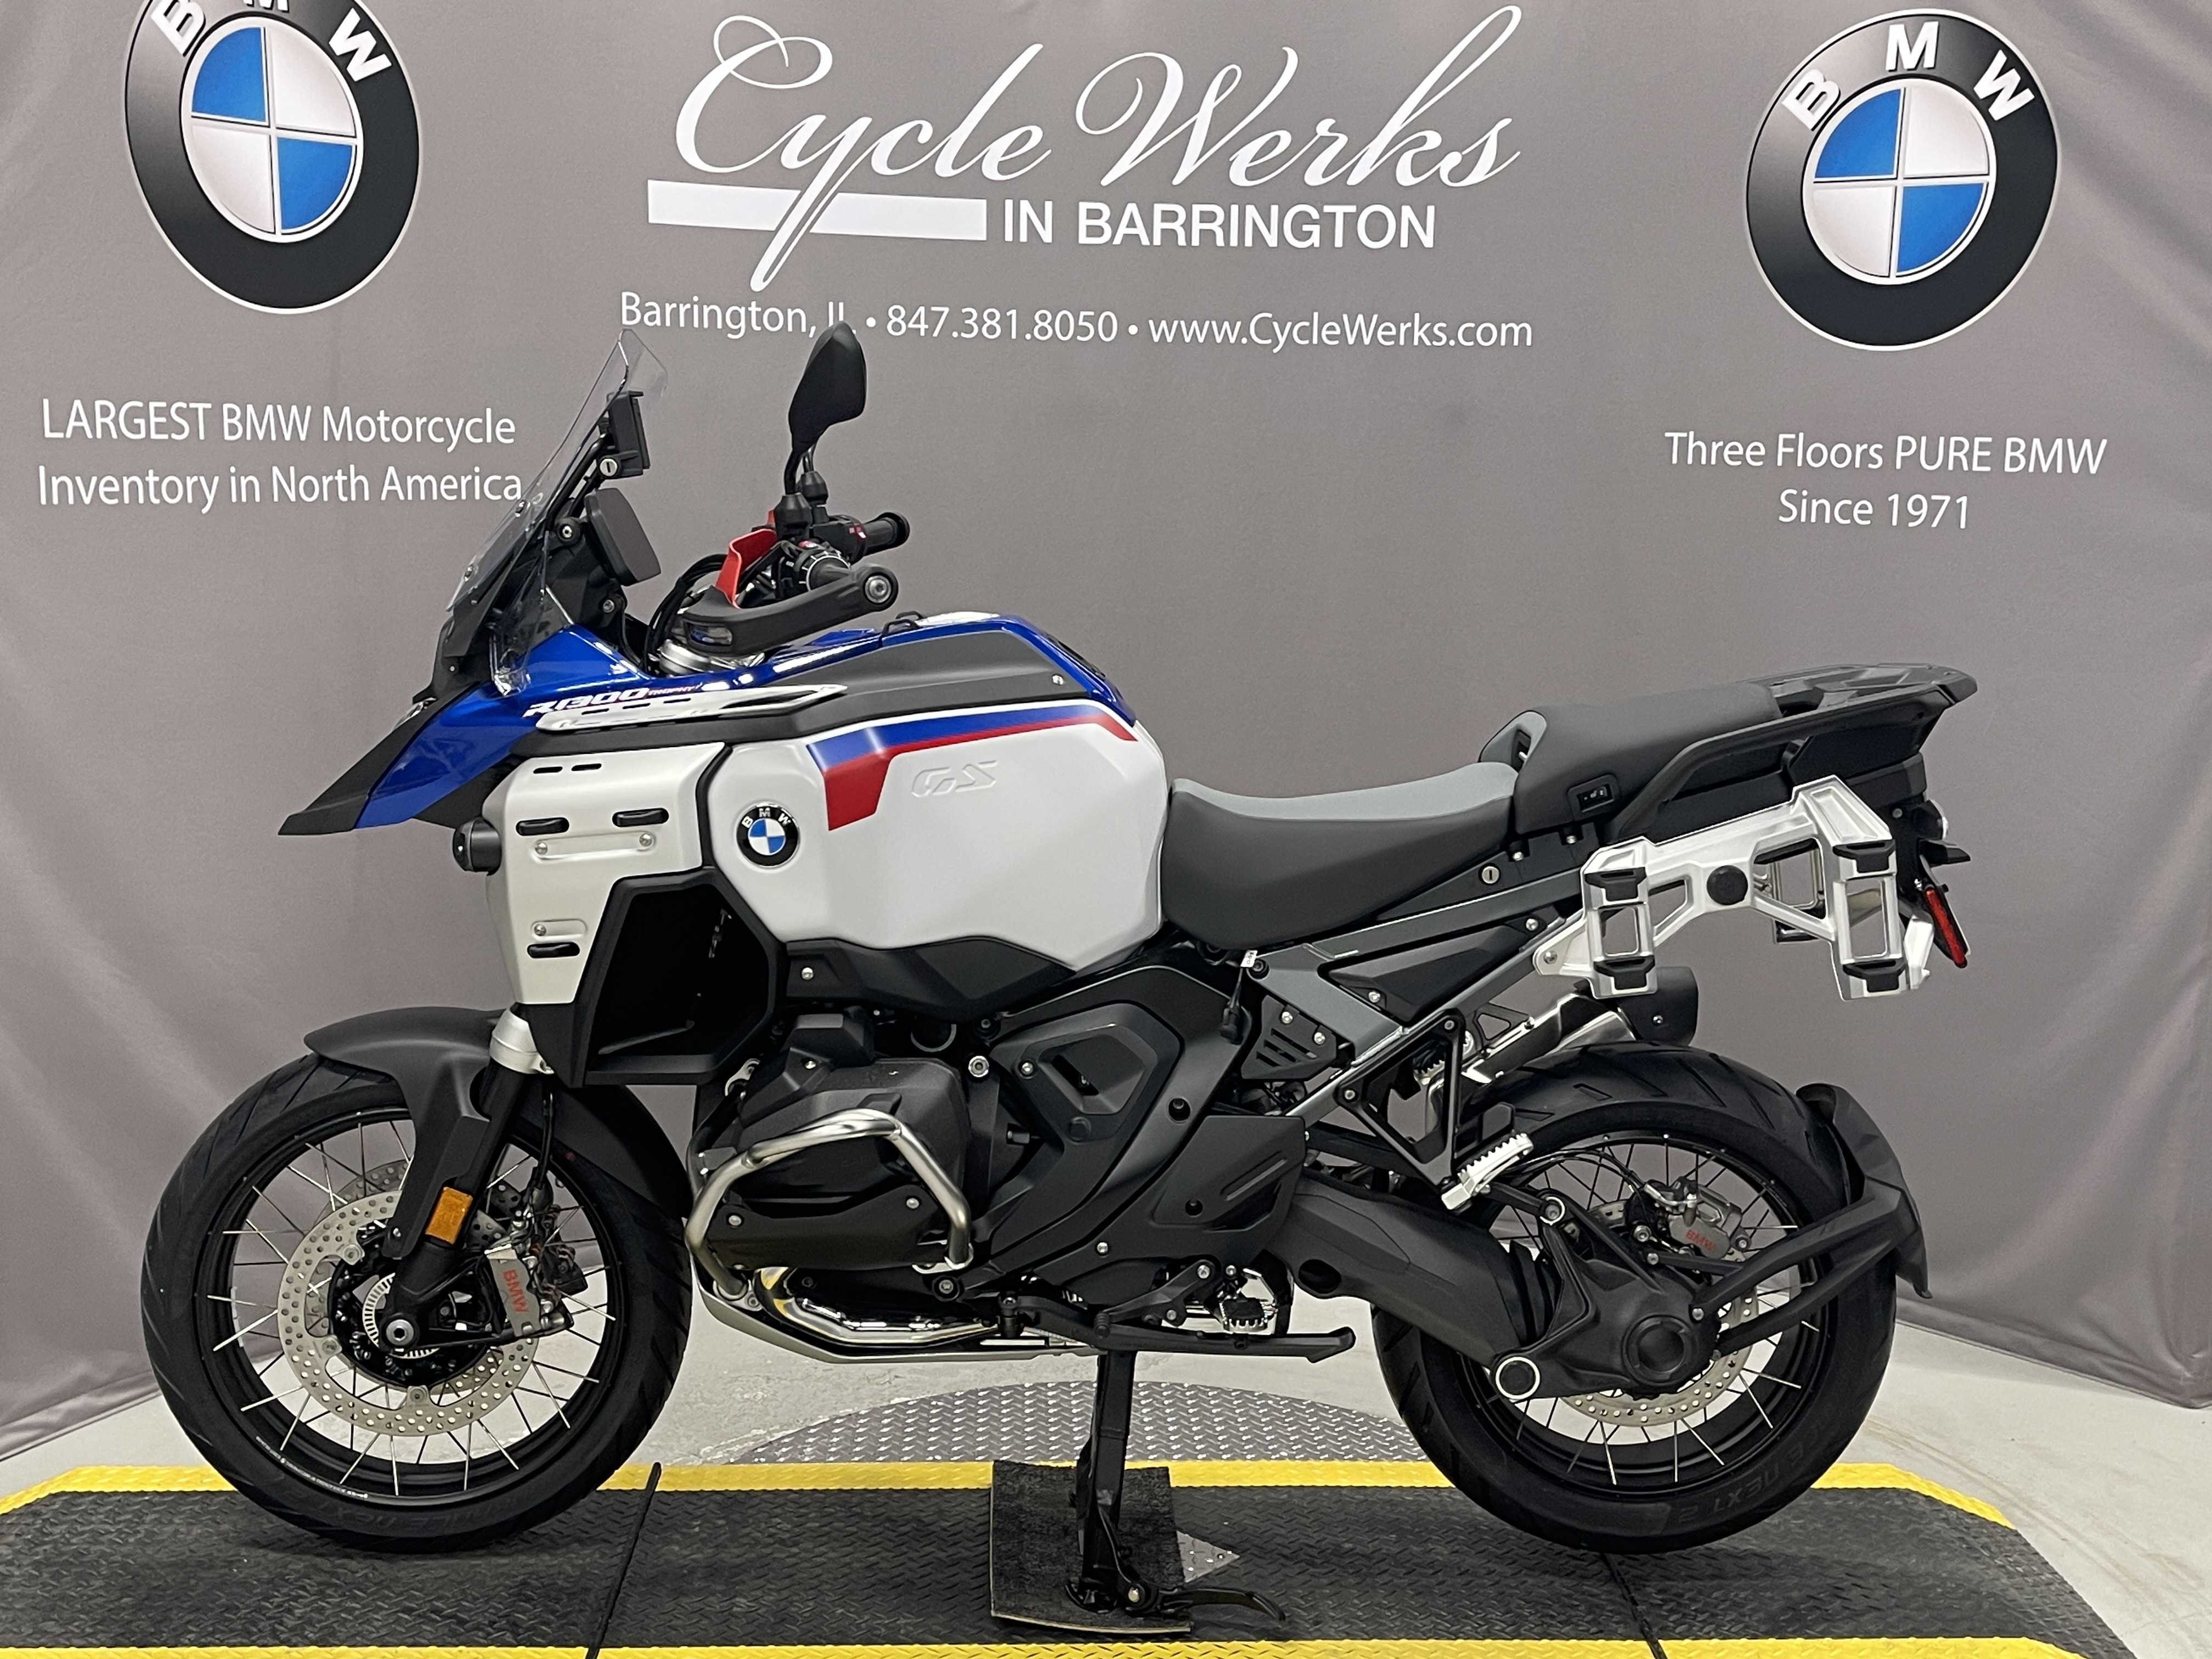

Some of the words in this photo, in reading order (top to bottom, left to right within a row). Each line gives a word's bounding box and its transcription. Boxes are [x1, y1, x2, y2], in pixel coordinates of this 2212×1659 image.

[150, 0, 392, 82] BW
[1781, 20, 2035, 131] BMW
[675, 15, 1052, 292] Cycle
[1075, 5, 1522, 188] Werks
[1004, 199, 1053, 244] IN
[1077, 201, 1435, 249] BARRINGTON
[620, 291, 817, 340] Barrington,
[886, 304, 1118, 342] 847.381.8050
[1148, 311, 1532, 354] www.CycleWerks.com
[42, 398, 212, 441] LARGEST
[222, 403, 312, 442] BMW
[323, 405, 516, 453] Motorcycle
[1664, 430, 1766, 467] Three
[1776, 432, 1884, 470] Floors
[1895, 435, 1993, 472] PURE
[2004, 437, 2108, 475] BMW
[38, 465, 220, 515] Inventory
[229, 465, 261, 503] in
[272, 464, 370, 503] North
[380, 465, 522, 501] America
[1778, 488, 1874, 526] Since
[1887, 493, 1968, 529] 1971
[911, 759, 998, 798] GS
[741, 807, 791, 828] BMW
[501, 1268, 529, 1313] BMW
